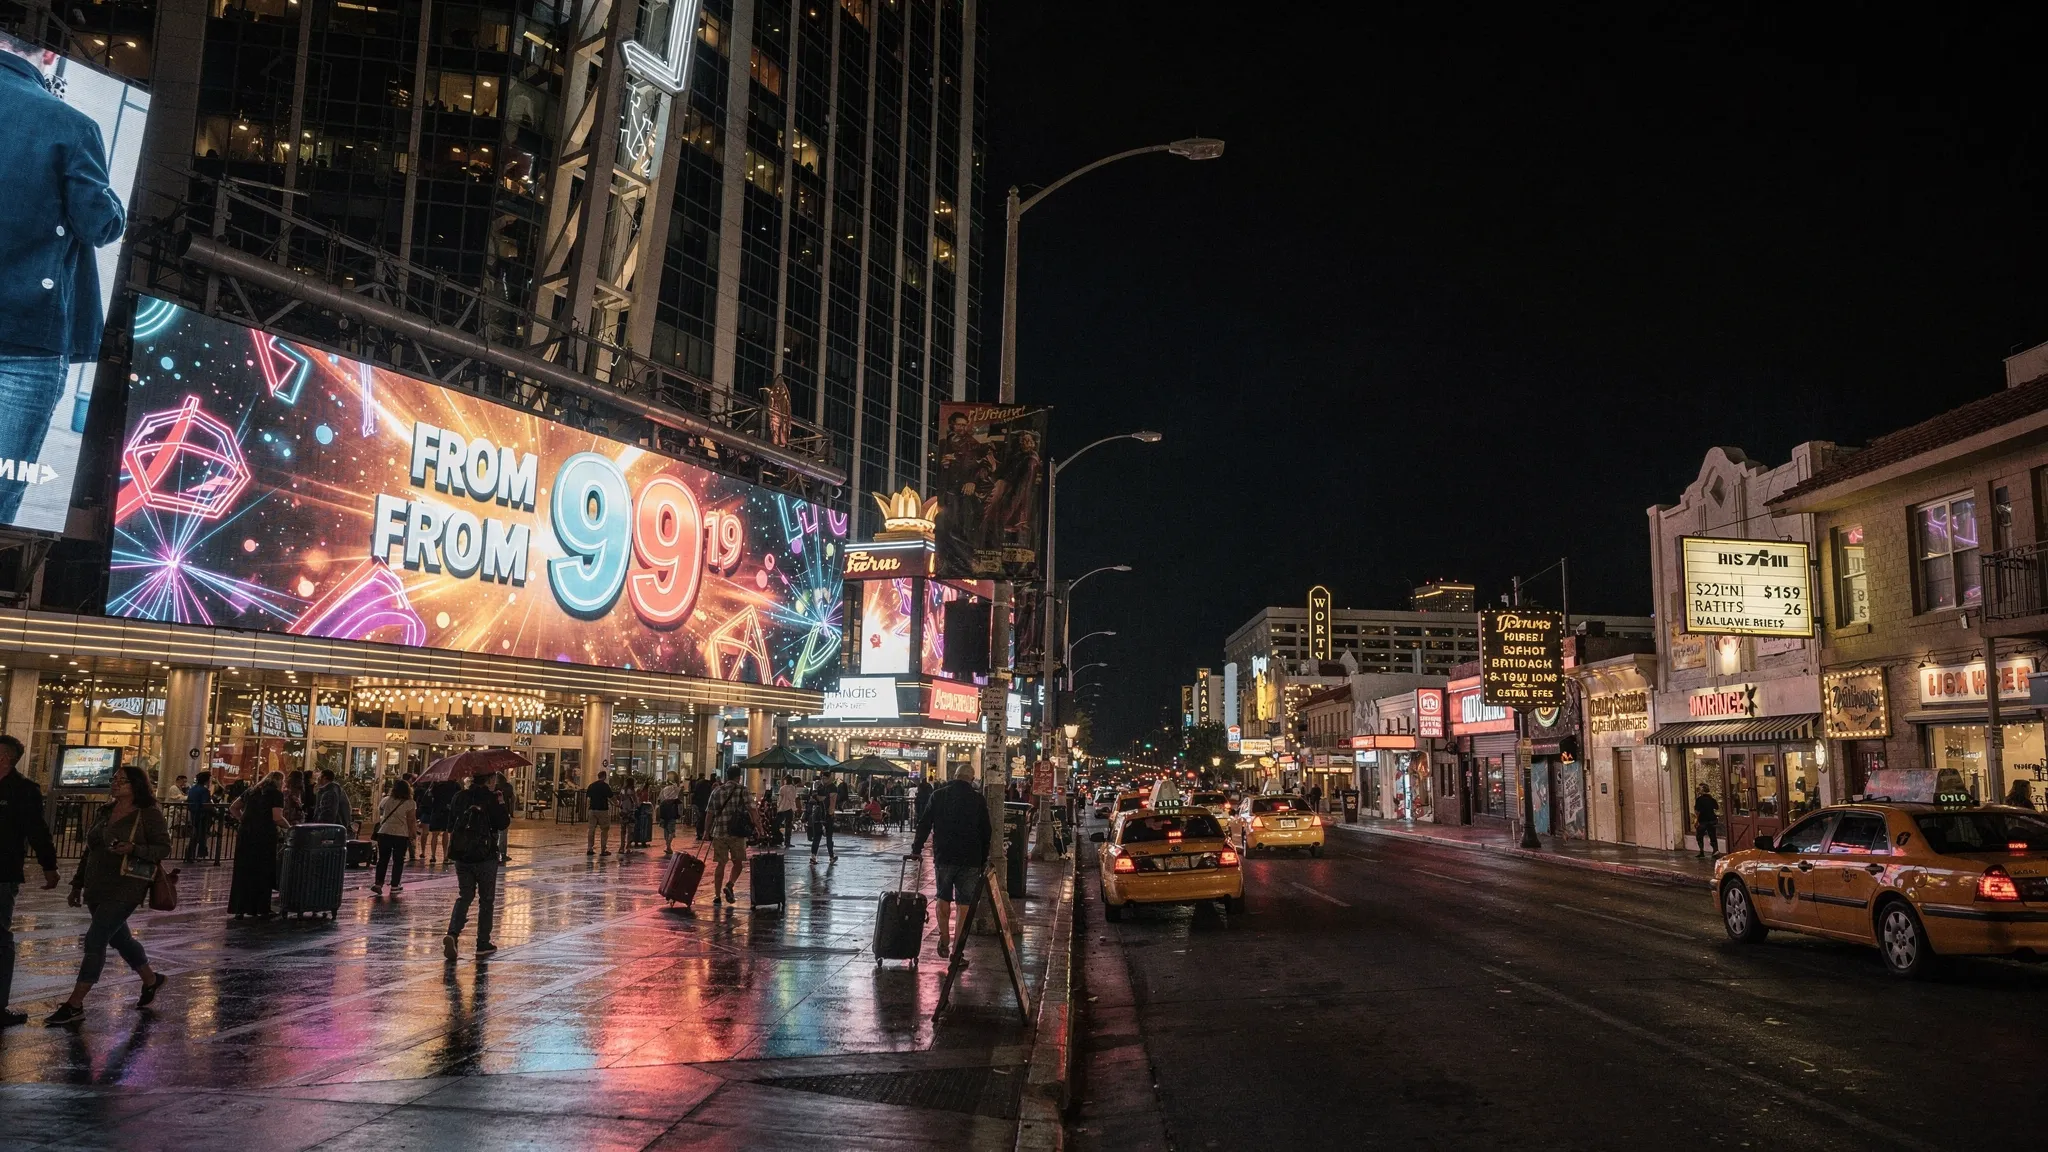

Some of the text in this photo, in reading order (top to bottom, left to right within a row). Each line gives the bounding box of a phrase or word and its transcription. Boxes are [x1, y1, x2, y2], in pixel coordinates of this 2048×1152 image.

[410, 421, 539, 512] FROM
[371, 493, 531, 587] FROM
[1764, 585, 1800, 599] $159
[1784, 603, 1801, 615] 26
